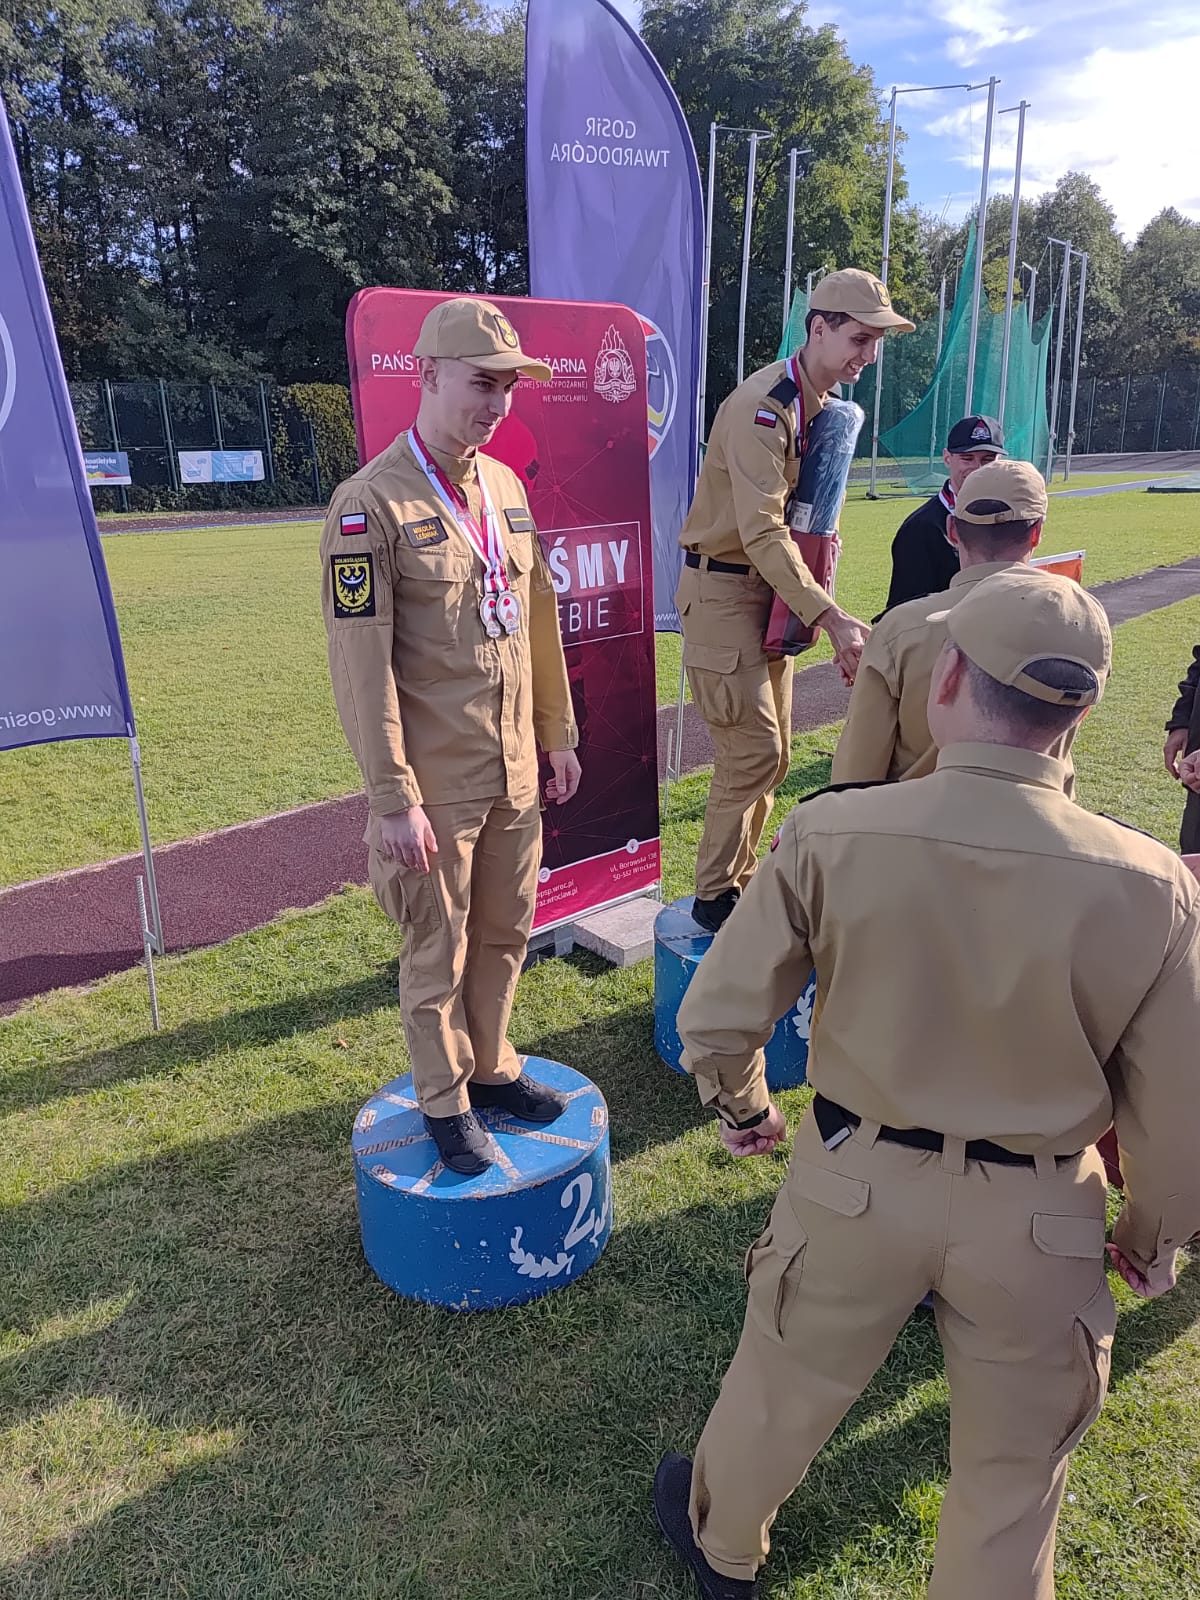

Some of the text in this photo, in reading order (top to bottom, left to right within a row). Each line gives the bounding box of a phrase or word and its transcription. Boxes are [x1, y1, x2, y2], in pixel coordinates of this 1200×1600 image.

[549, 536, 629, 594] ŚMY
[536, 886, 578, 908] raz.wroclaw.pl
[560, 1172, 596, 1251] 2
